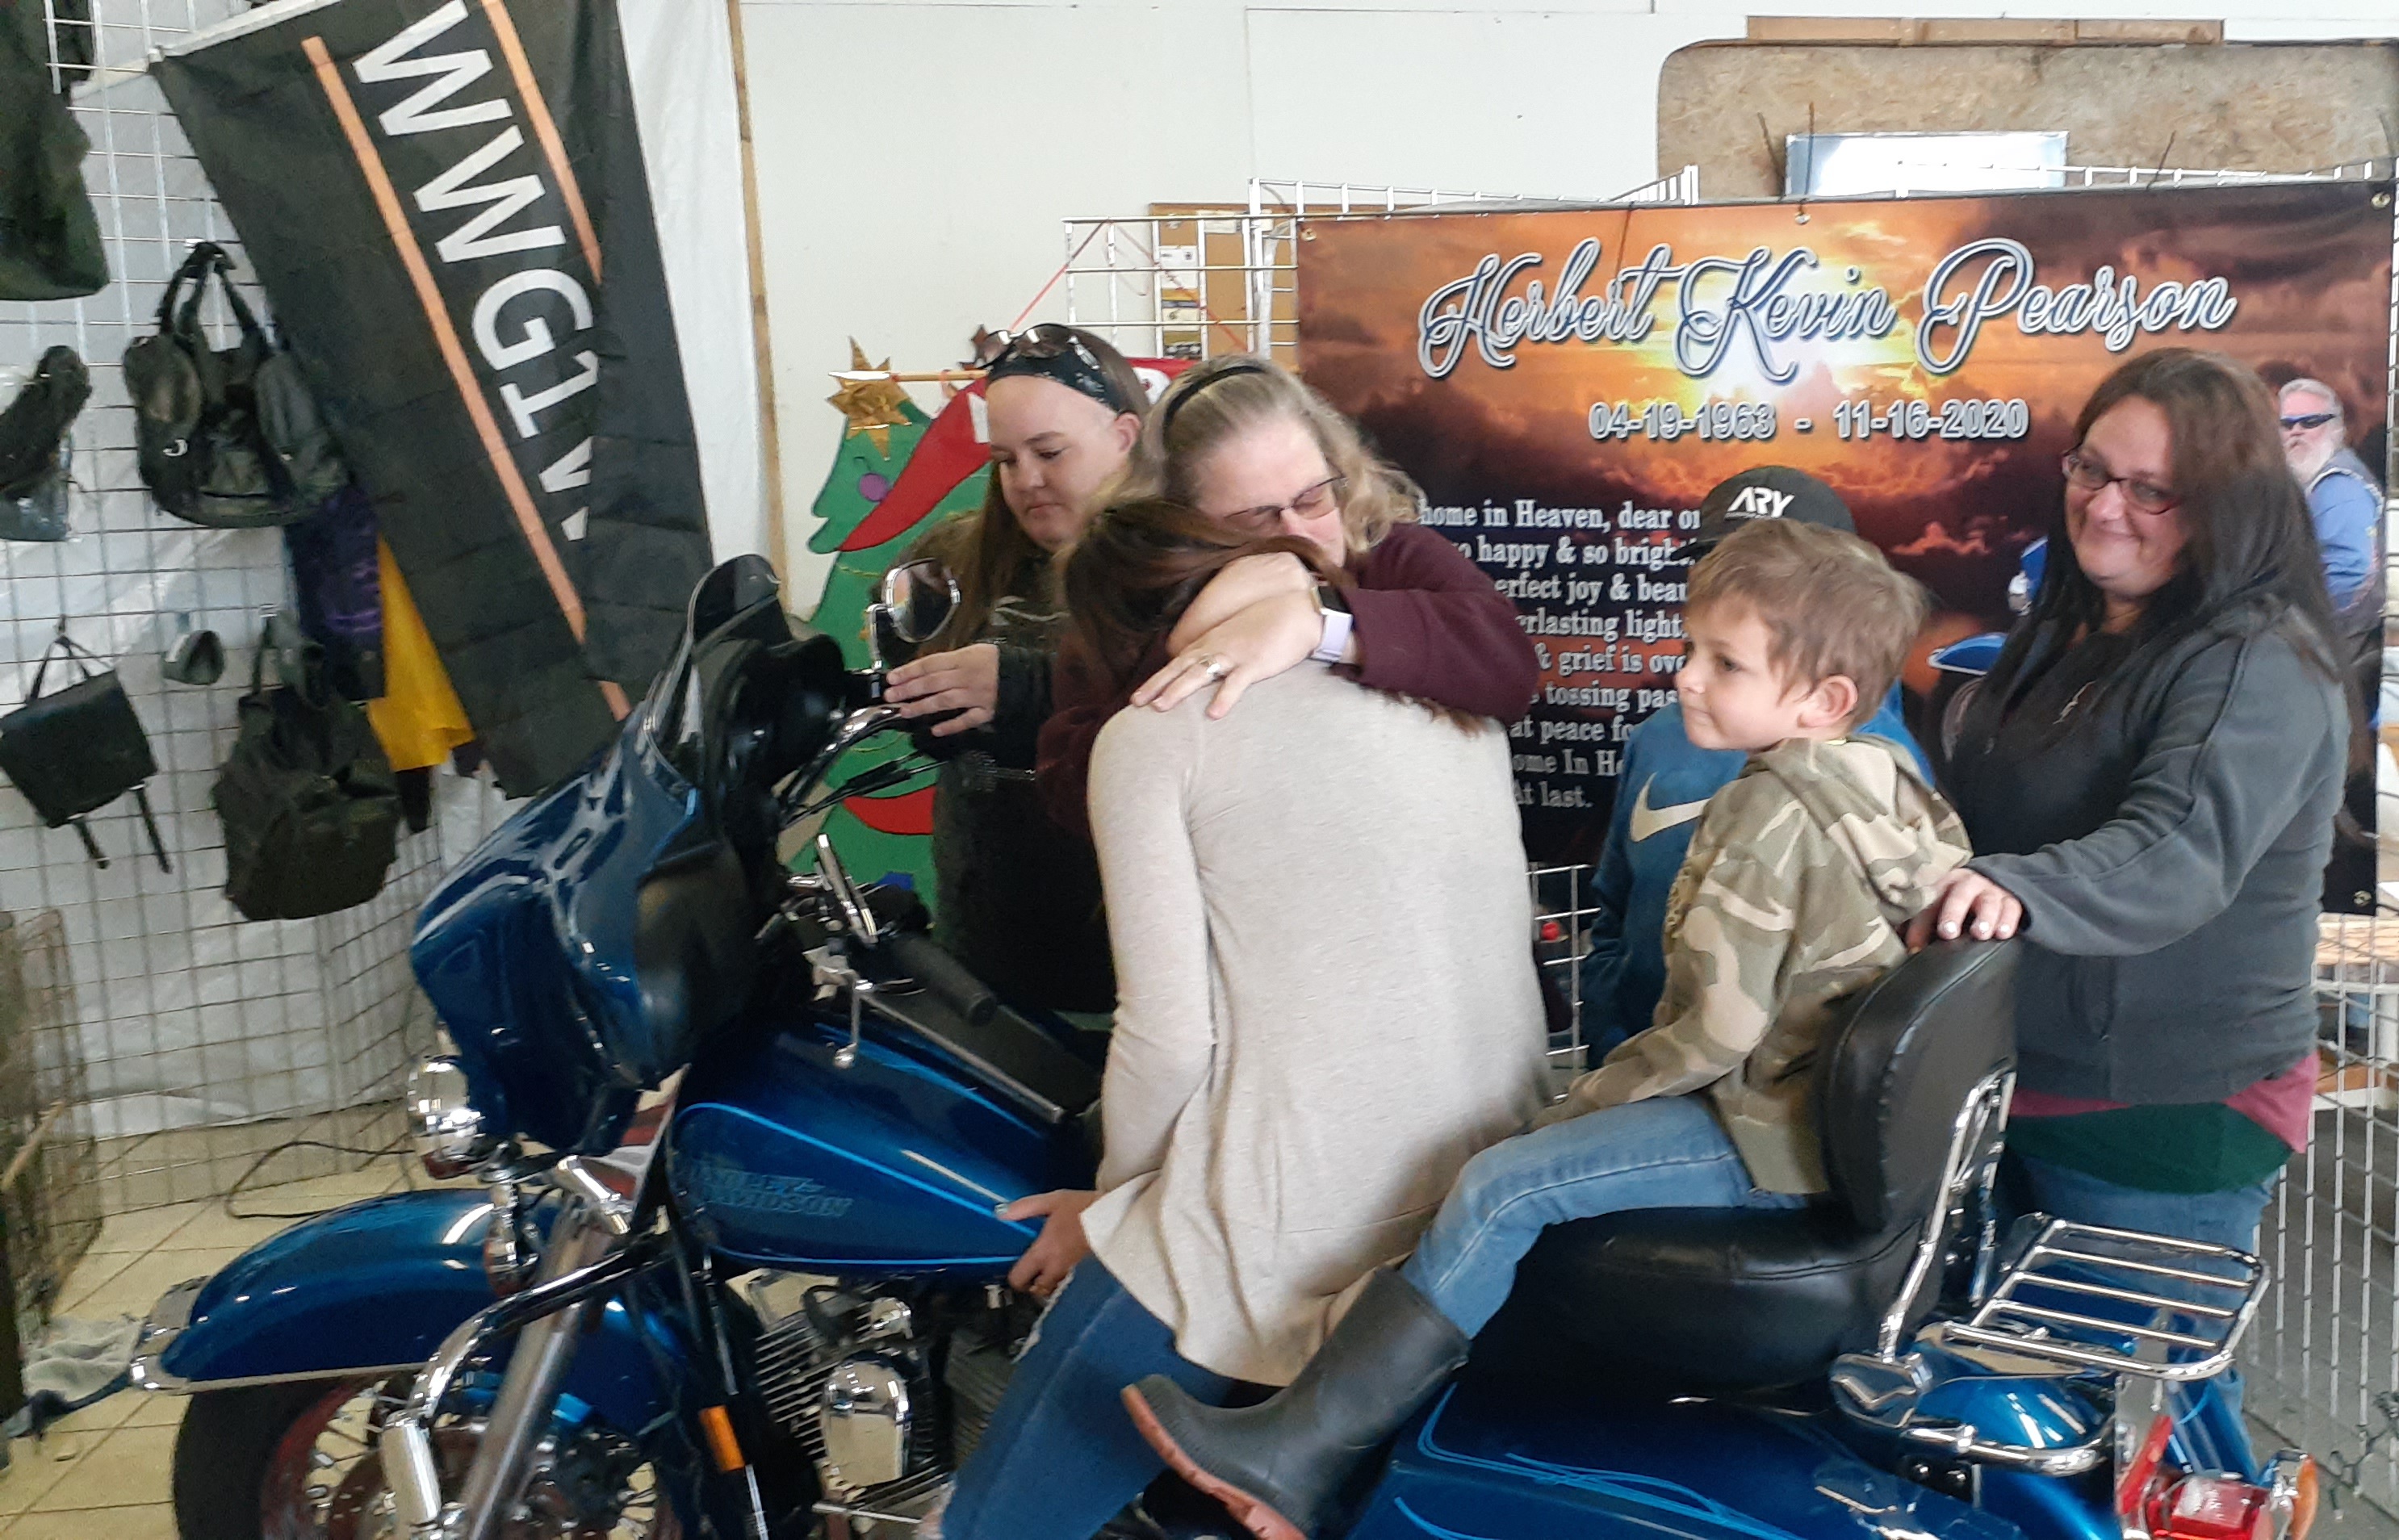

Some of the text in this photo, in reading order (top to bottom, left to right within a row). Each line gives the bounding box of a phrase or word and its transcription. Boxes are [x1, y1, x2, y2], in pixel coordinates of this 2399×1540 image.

[1418, 236, 2238, 384] Herbert Kevin Pearson
[1589, 401, 1777, 441] 04-19-1963
[1833, 397, 2029, 438] 11-16-2020
[1418, 498, 1478, 526] home
[1483, 498, 1509, 527] in
[1515, 499, 1611, 533] Heaven,
[1618, 500, 1673, 529] dear
[1476, 534, 1550, 569] happy
[1555, 538, 1576, 564] &
[1583, 545, 1609, 565] so
[1565, 572, 1603, 605] joy
[1610, 573, 1631, 601] &
[1559, 644, 1617, 676] grief
[1621, 646, 1643, 672] is
[1545, 681, 1631, 712] tossing
[1509, 714, 1534, 738] at
[1539, 721, 1606, 744] peace
[1562, 748, 1589, 775] In
[1539, 781, 1593, 807] last.
